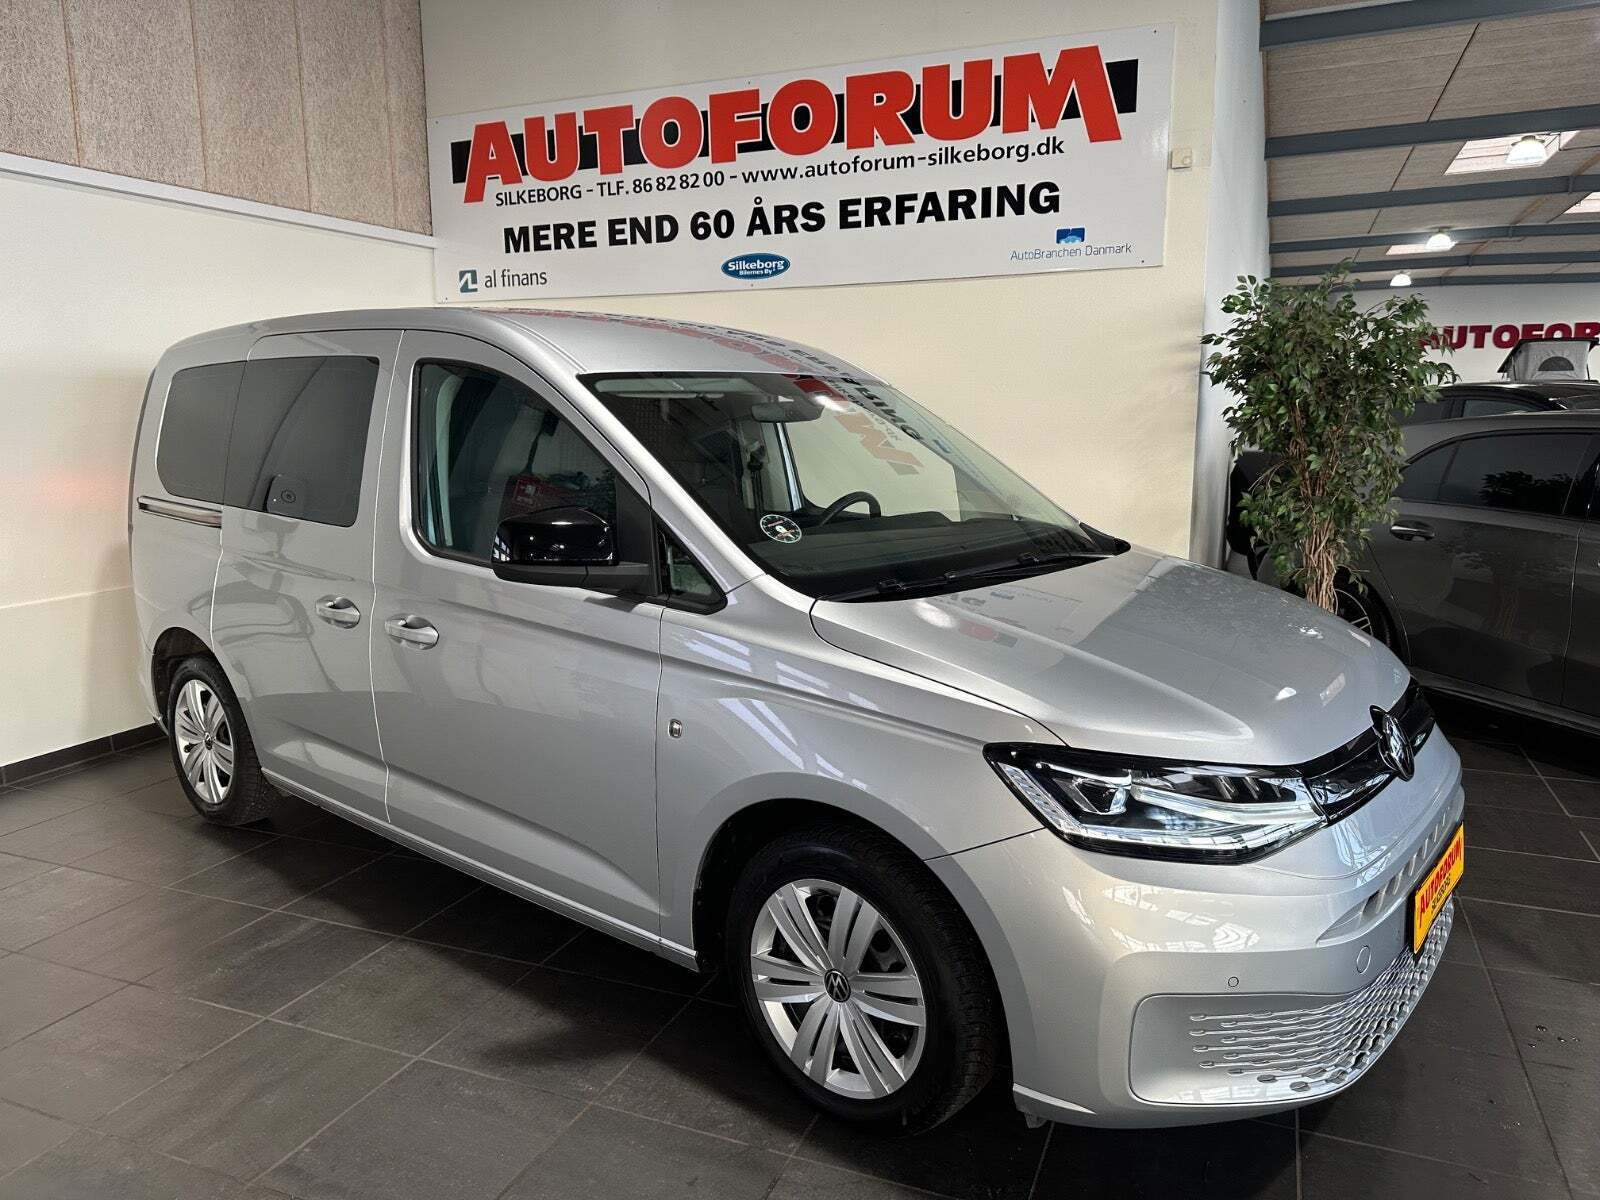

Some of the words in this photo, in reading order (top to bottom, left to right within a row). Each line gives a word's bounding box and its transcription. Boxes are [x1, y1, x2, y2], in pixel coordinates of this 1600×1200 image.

[463, 44, 1122, 204] AUTOFORUM
[495, 184, 582, 207] SILKEBORG
[597, 180, 630, 197] TLF.
[632, 177, 652, 195] 86
[742, 136, 1065, 184] www.autoforum-silkeborg.dk
[503, 220, 598, 254] MERE
[608, 213, 679, 247] END
[690, 209, 735, 241] 60
[746, 196, 826, 237] ÅRS
[839, 181, 1060, 230] ERFARING
[728, 259, 785, 271] Silkeborg
[1010, 247, 1081, 260] AutoBranchen
[1085, 243, 1132, 256] Danmark
[484, 269, 497, 288] al
[501, 269, 548, 287] finans
